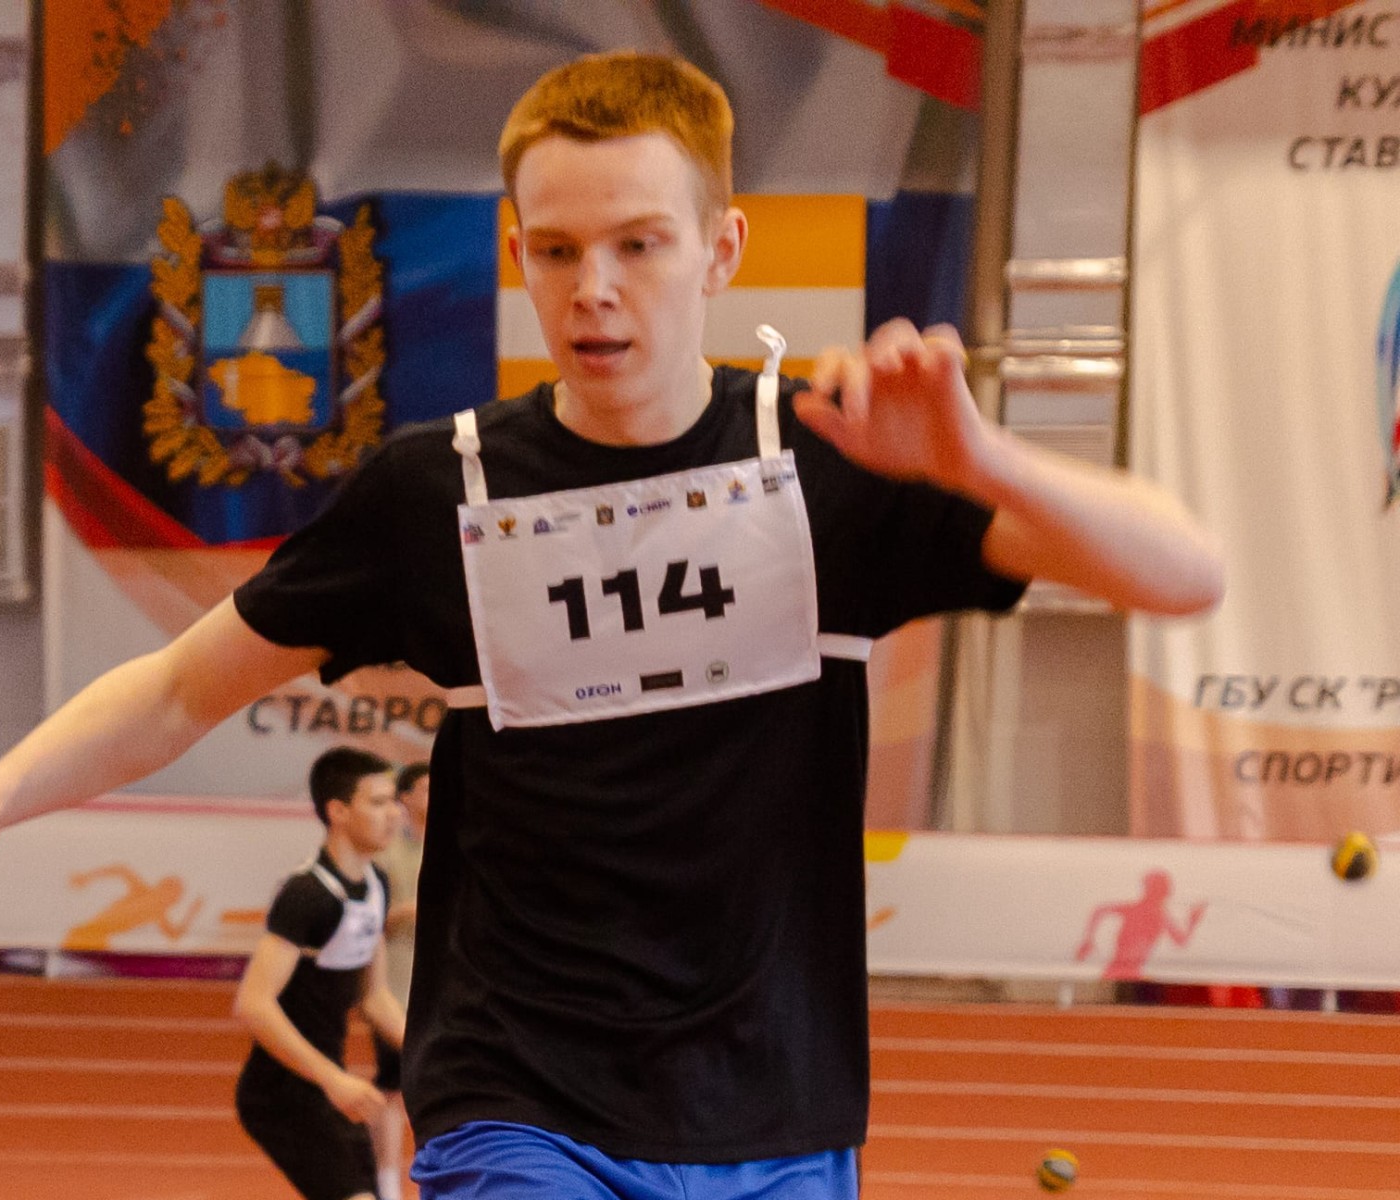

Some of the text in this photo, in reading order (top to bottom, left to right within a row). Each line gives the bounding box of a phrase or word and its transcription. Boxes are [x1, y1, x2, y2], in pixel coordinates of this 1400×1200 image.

[1287, 135, 1400, 170] СТАВ
[547, 558, 736, 642] 114
[575, 682, 622, 700] OZON
[1193, 674, 1279, 709] ГБУ
[1288, 675, 1347, 710] СК
[246, 695, 449, 735] СТАВРО
